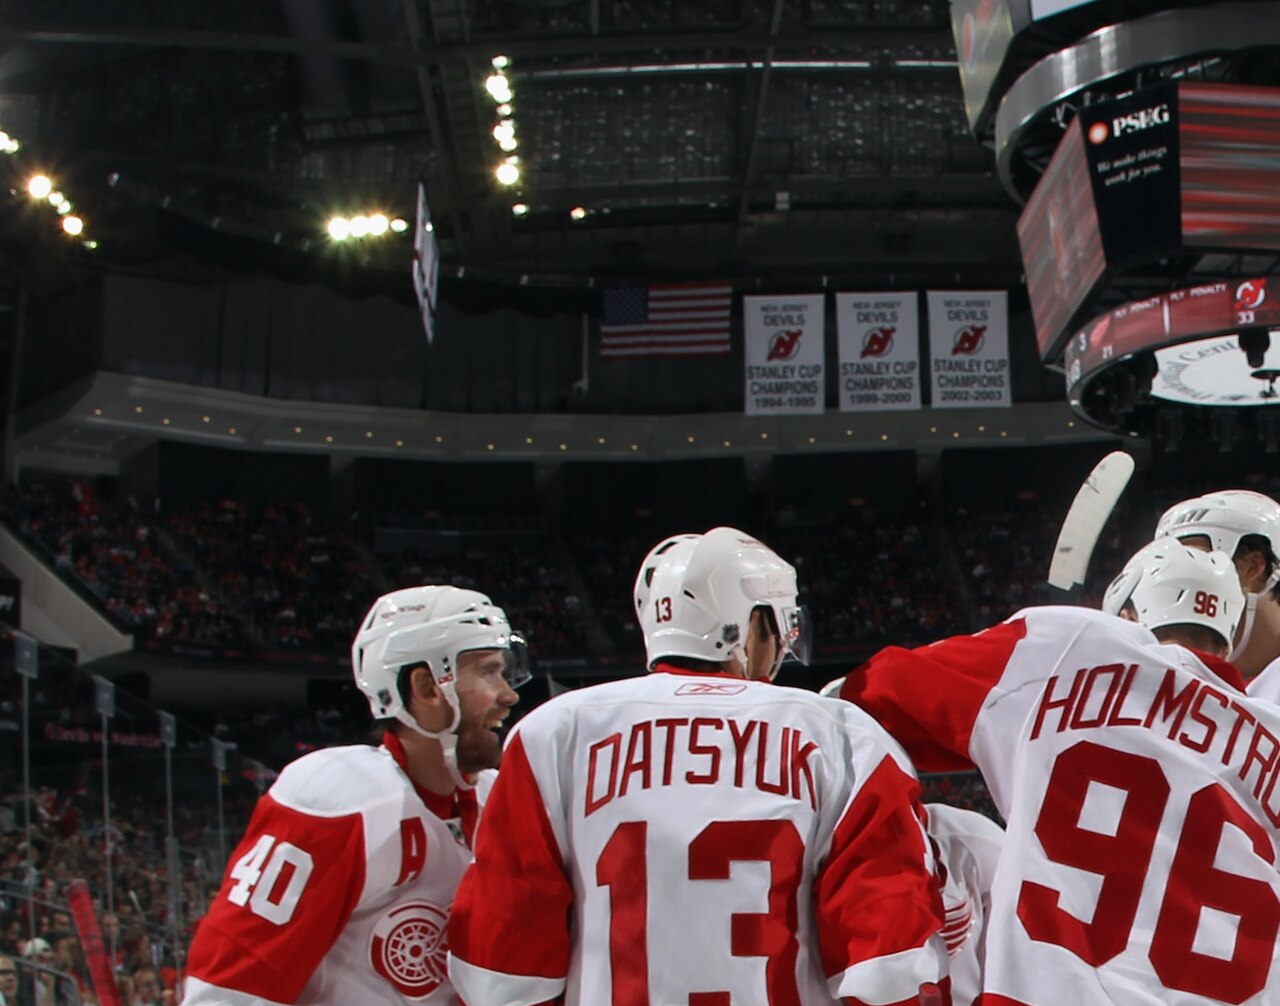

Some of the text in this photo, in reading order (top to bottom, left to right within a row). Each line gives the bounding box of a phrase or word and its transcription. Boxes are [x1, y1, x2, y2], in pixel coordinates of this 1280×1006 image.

[763, 313, 806, 327] DEVILS
[856, 311, 899, 324] DEVILS
[947, 309, 989, 322] DEVILS
[1238, 310, 1255, 325] 33
[748, 364, 822, 379] STANLEY CUP
[842, 360, 917, 376] STANLEY CUP
[933, 359, 1009, 373] STANLEY CUP
[751, 380, 819, 395] CHAMPIONS
[845, 377, 915, 391] CHAMPIONS
[937, 375, 1005, 388] CHAMPIONS
[655, 596, 673, 623] 13
[1193, 590, 1218, 618] 96
[584, 716, 821, 818] DATSYUK
[227, 833, 314, 926] 40
